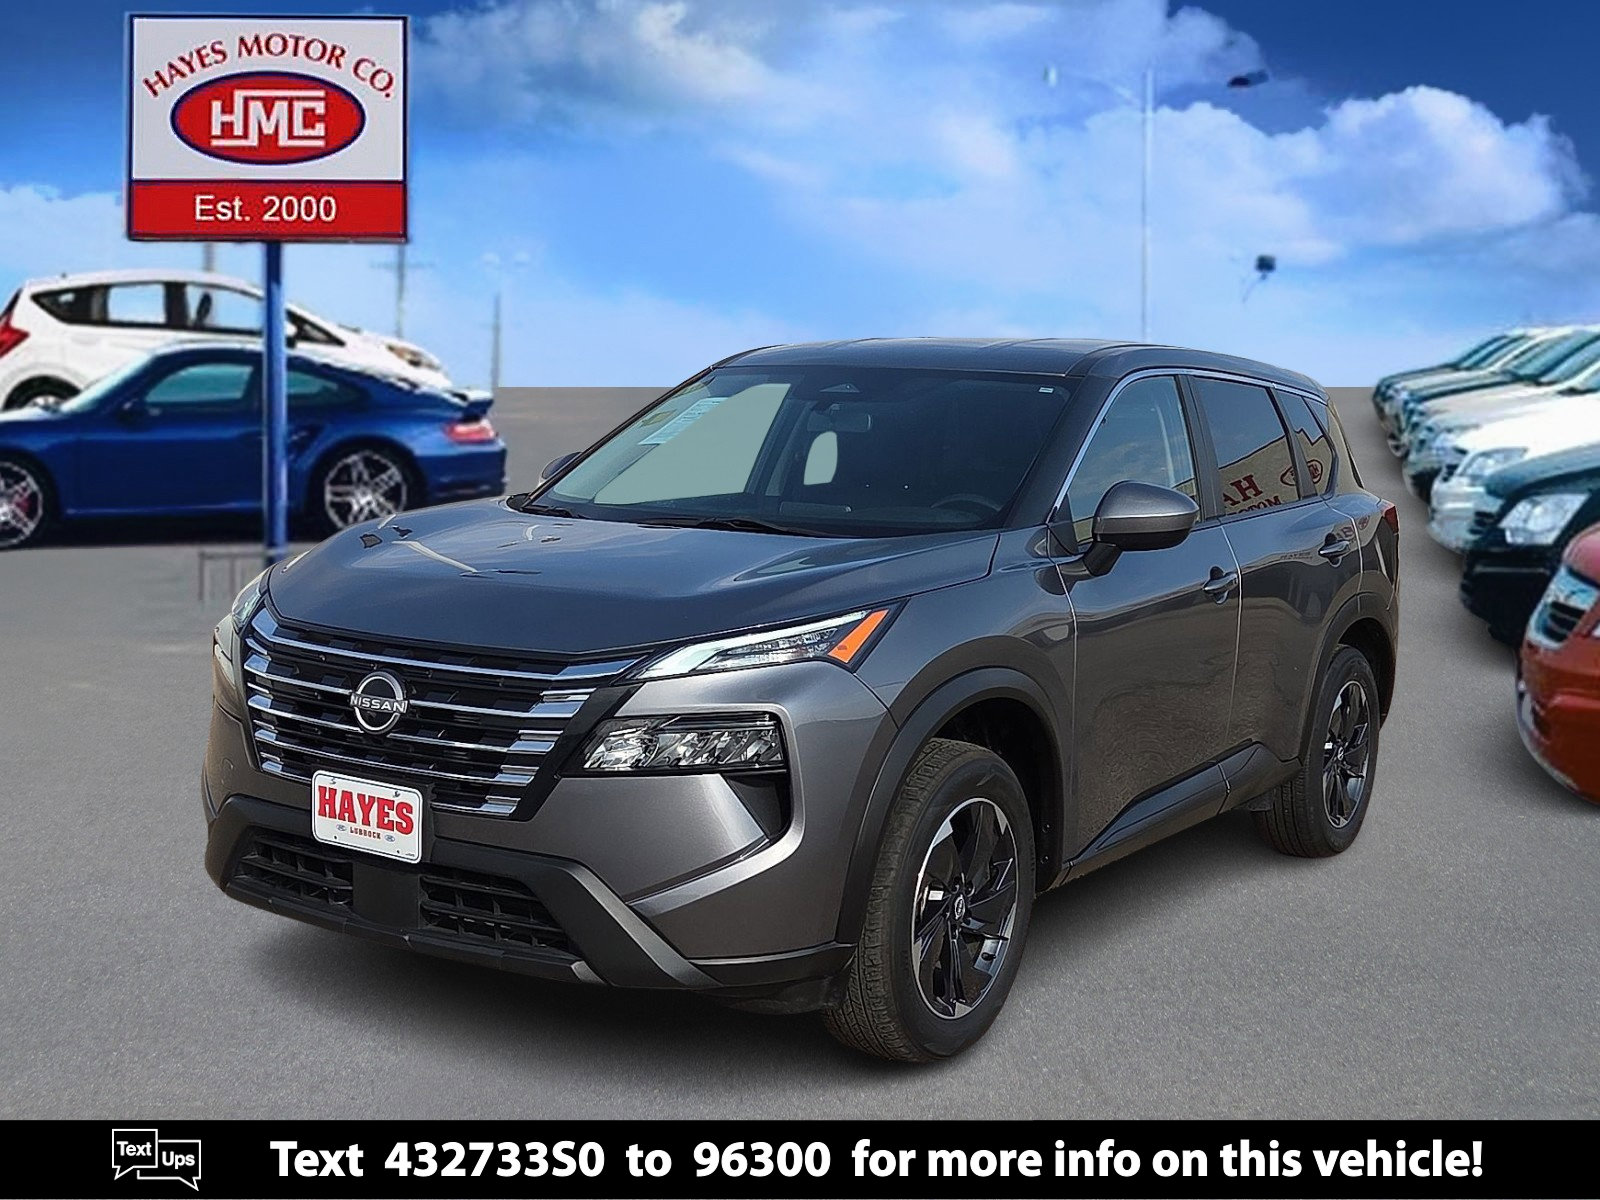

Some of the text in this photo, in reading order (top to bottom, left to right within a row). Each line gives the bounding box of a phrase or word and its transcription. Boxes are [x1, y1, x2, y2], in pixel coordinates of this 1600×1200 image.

[142, 32, 395, 98] HAYES MOTOR CO.
[209, 88, 326, 148] HMC
[194, 195, 337, 222] Est. 2000
[350, 693, 408, 714] NISSAN
[317, 785, 415, 836] HAYES
[349, 826, 382, 840] LUBBOCK
